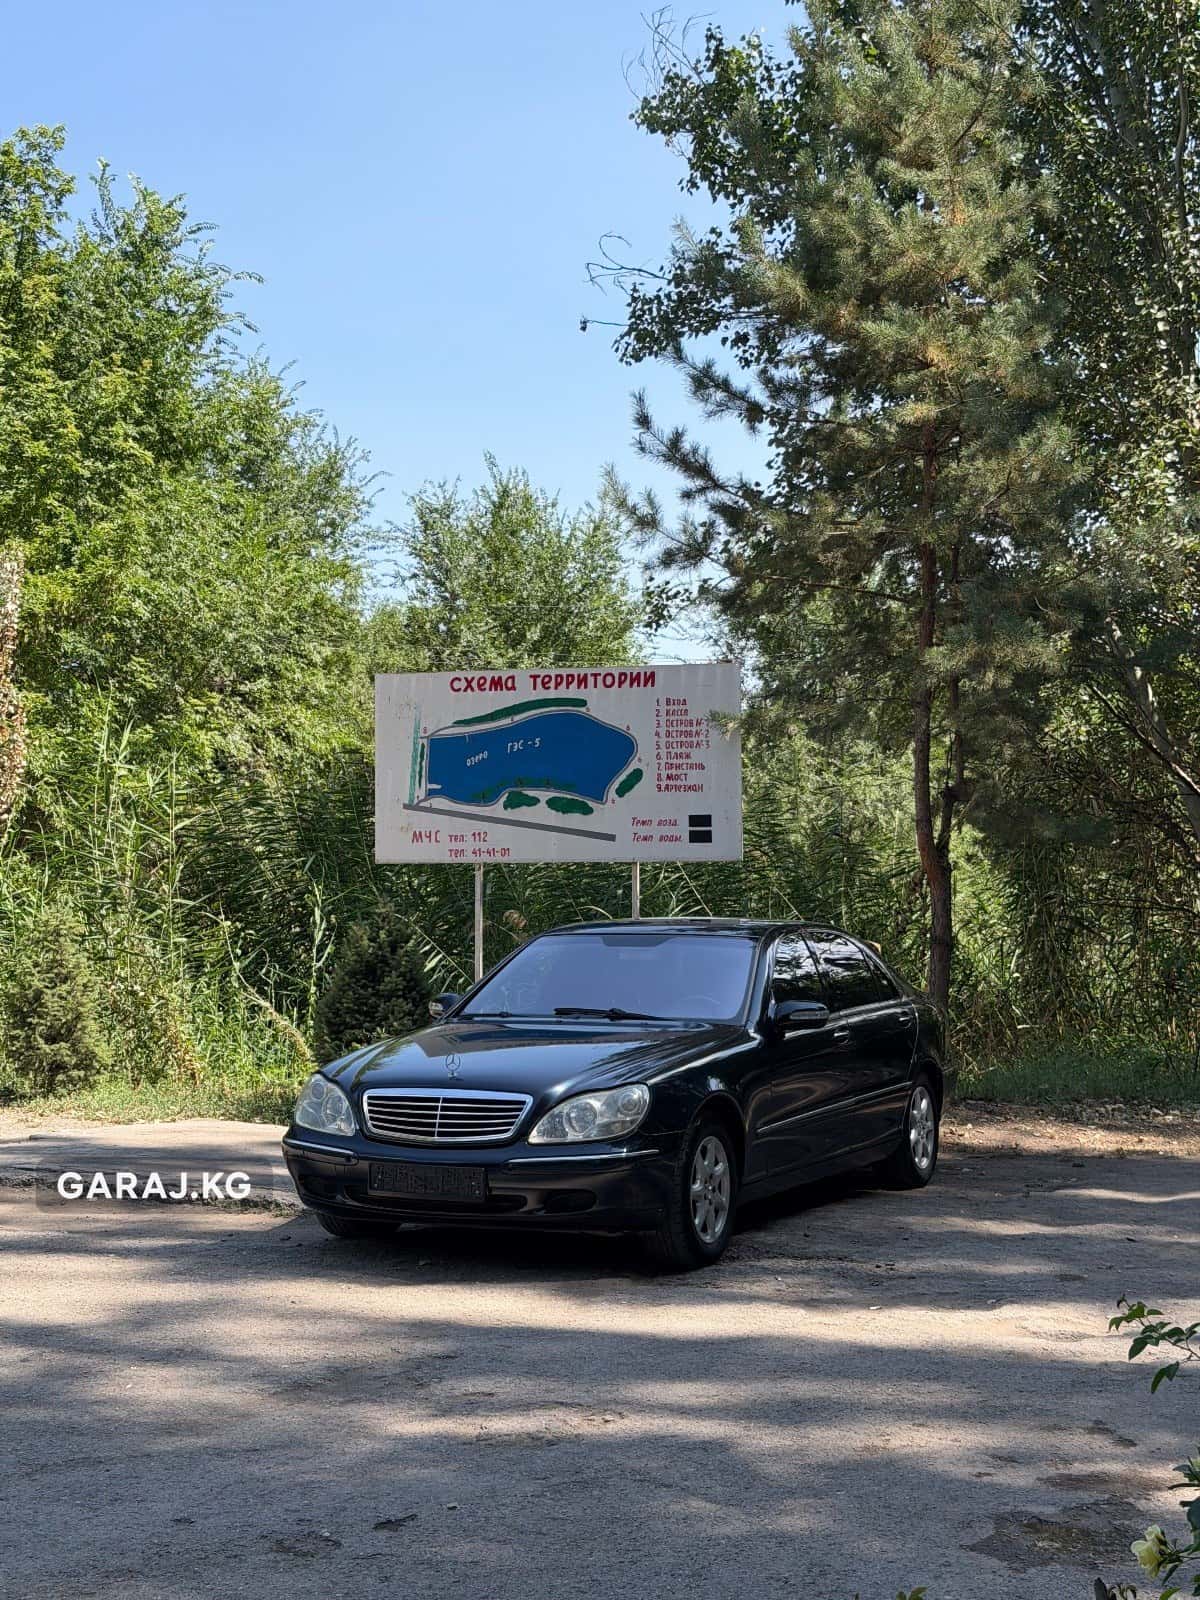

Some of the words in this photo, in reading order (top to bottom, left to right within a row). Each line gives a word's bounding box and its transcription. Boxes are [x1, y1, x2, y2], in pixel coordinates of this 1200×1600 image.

[655, 709, 662, 718] 2.
[655, 719, 662, 728] 3.
[655, 740, 662, 750] 5.
[655, 752, 663, 761] 6.
[411, 829, 441, 844] МЧС
[470, 831, 488, 843] 112
[471, 847, 511, 858] 41-41-01
